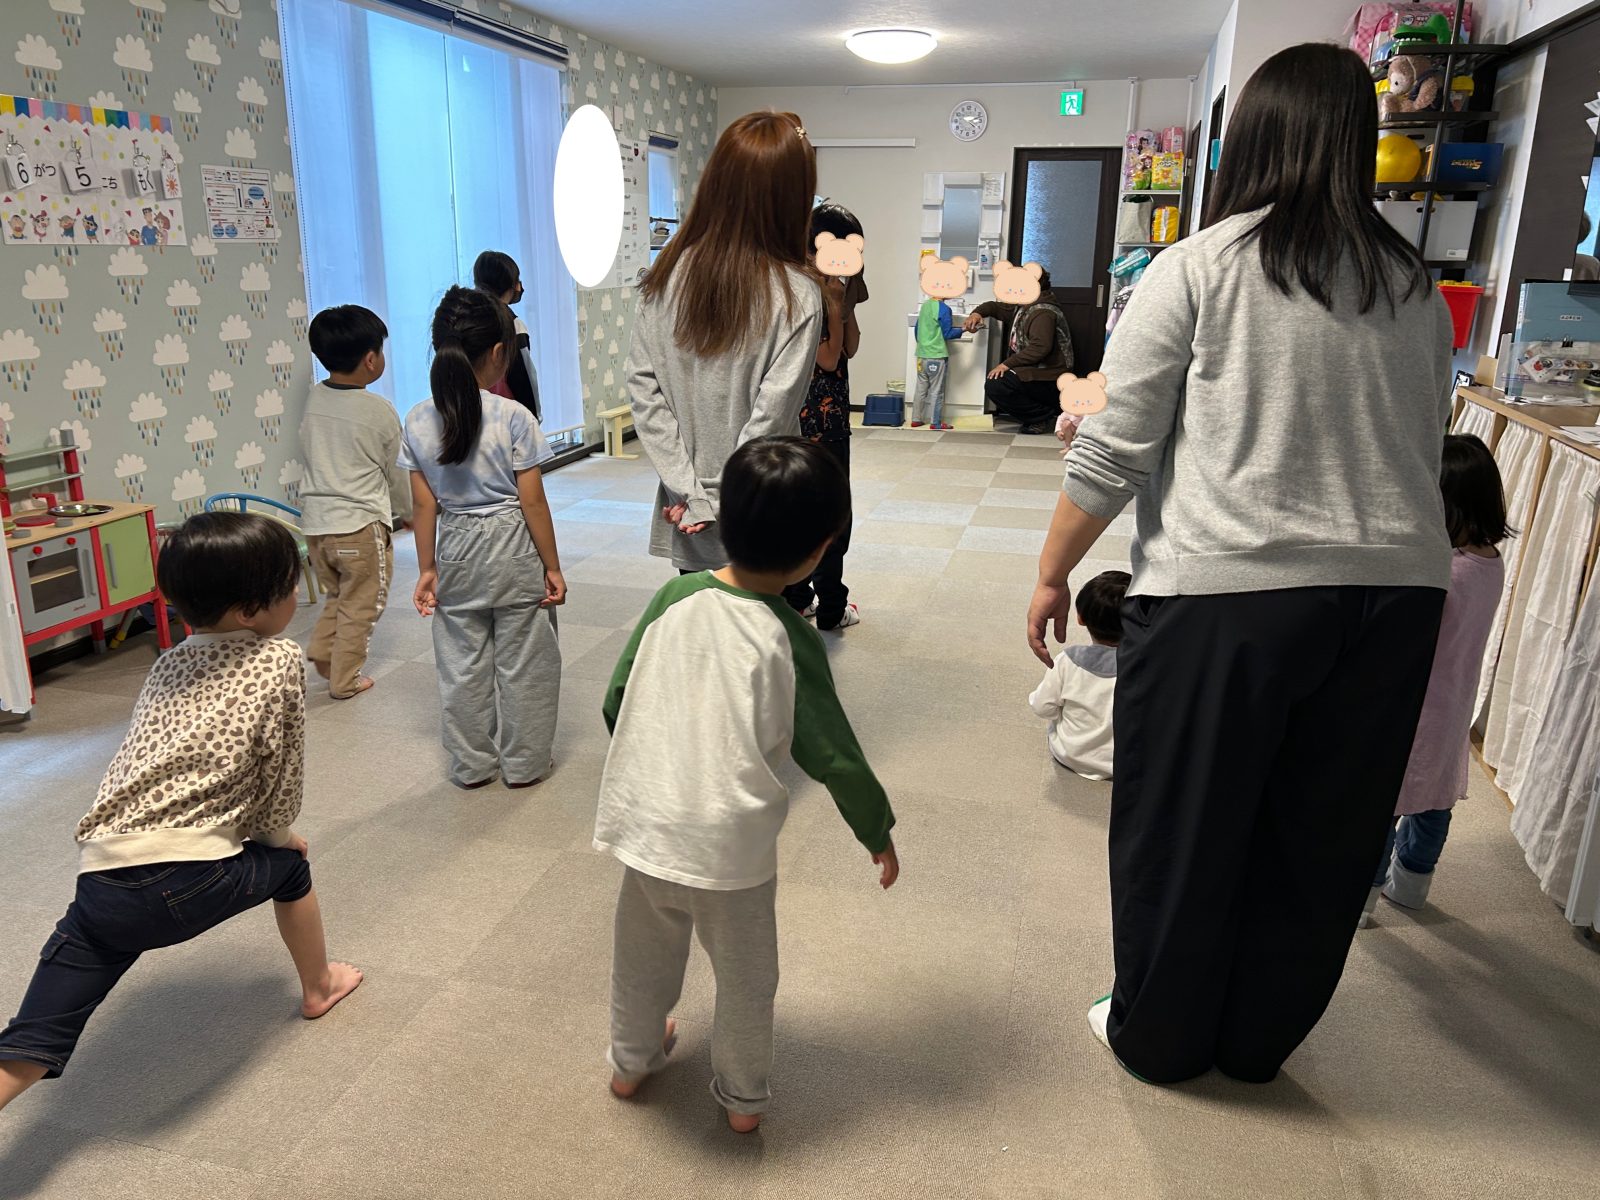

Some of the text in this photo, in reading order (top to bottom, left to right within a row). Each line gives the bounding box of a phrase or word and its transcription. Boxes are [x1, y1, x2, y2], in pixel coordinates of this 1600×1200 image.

[16, 162, 29, 184] 6
[34, 163, 57, 178] がつ
[75, 166, 92, 187] 5
[137, 168, 154, 191] もく
